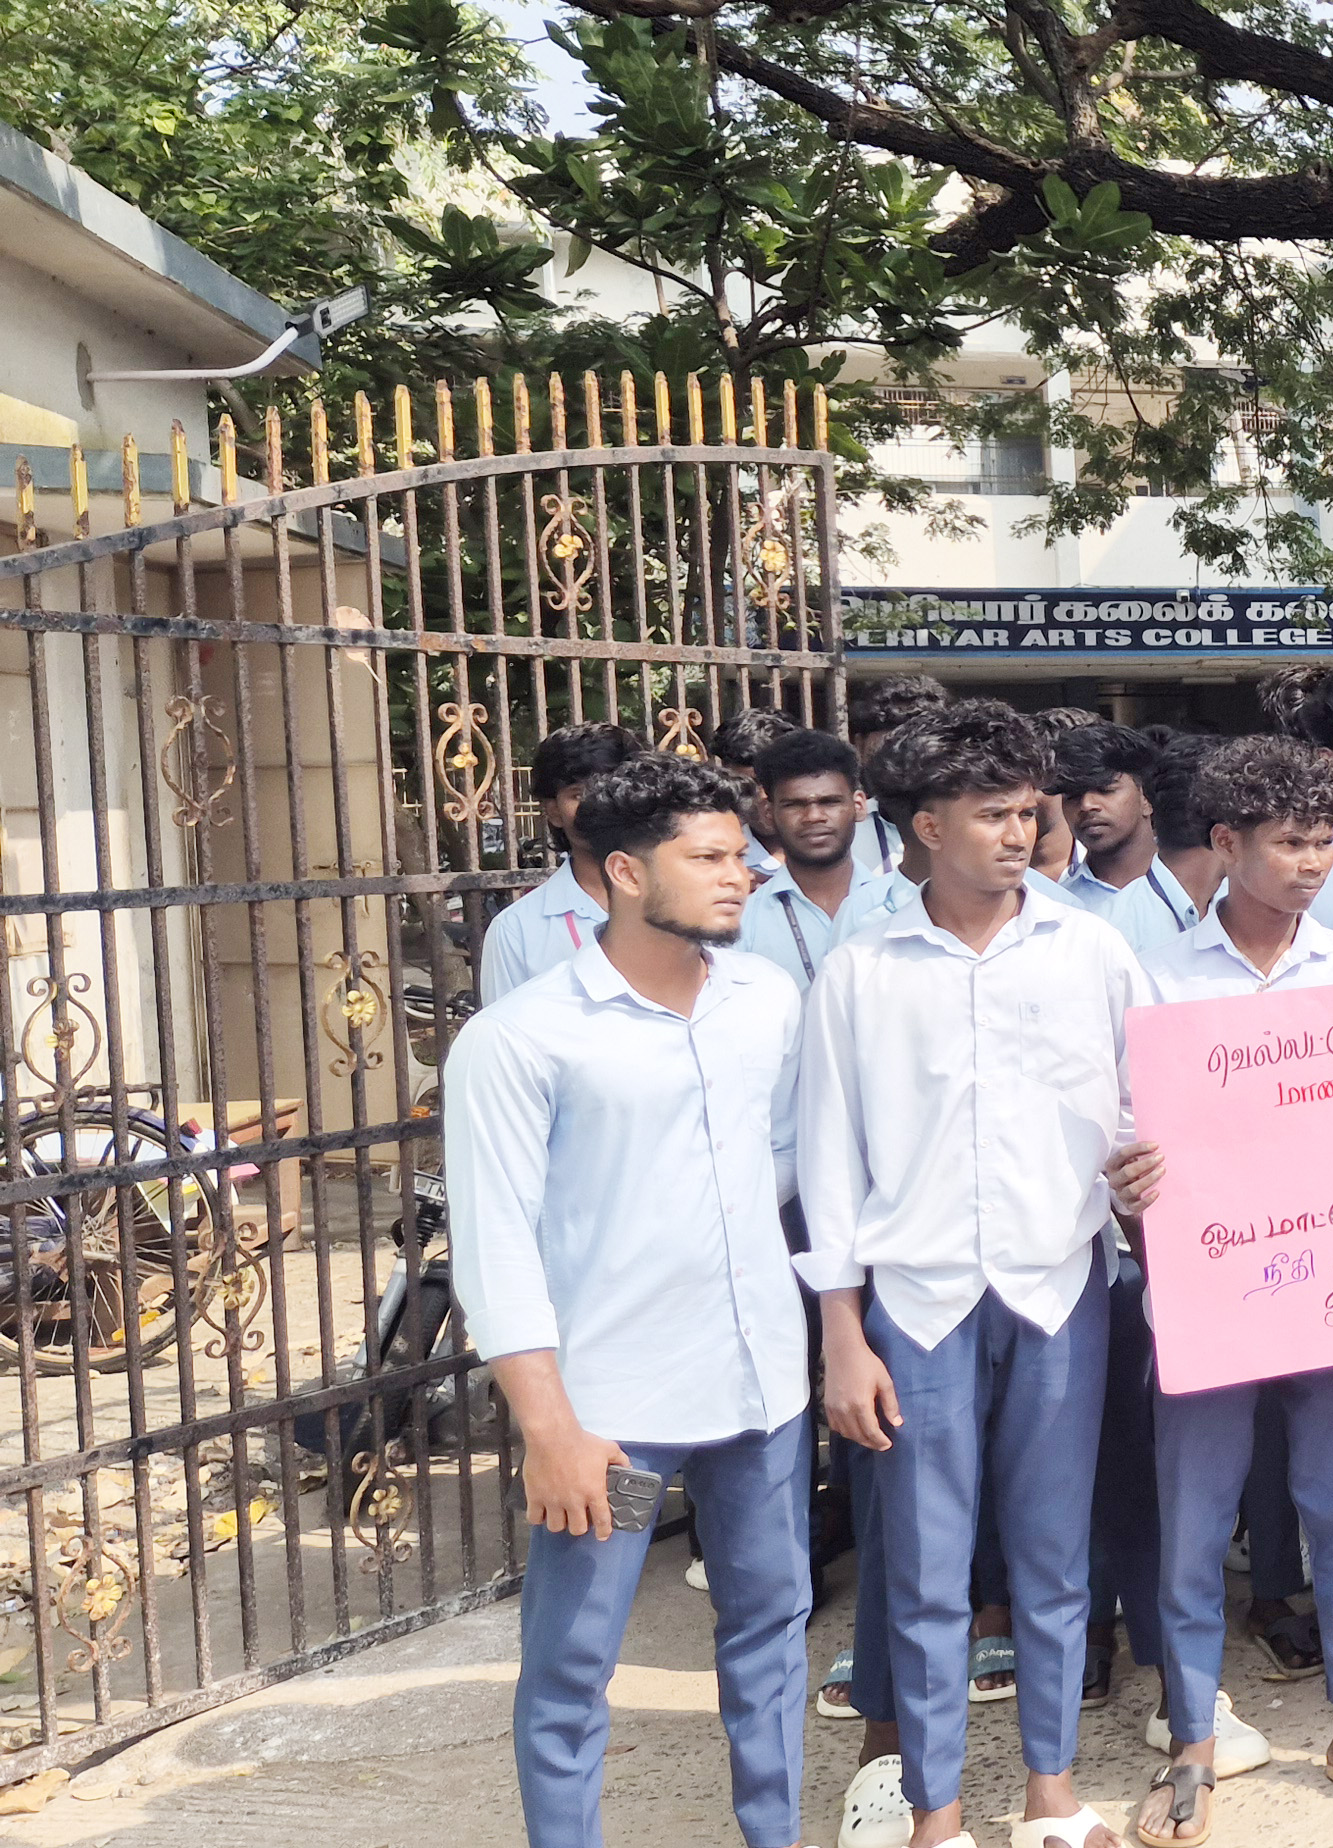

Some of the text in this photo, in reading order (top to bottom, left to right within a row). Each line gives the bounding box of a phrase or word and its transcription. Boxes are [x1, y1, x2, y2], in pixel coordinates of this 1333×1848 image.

[1053, 594, 1234, 622] கலைக்
[1020, 629, 1132, 647] ARTS
[1142, 628, 1333, 646] COLLEGE
[1243, 1249, 1315, 1300] நீதி
